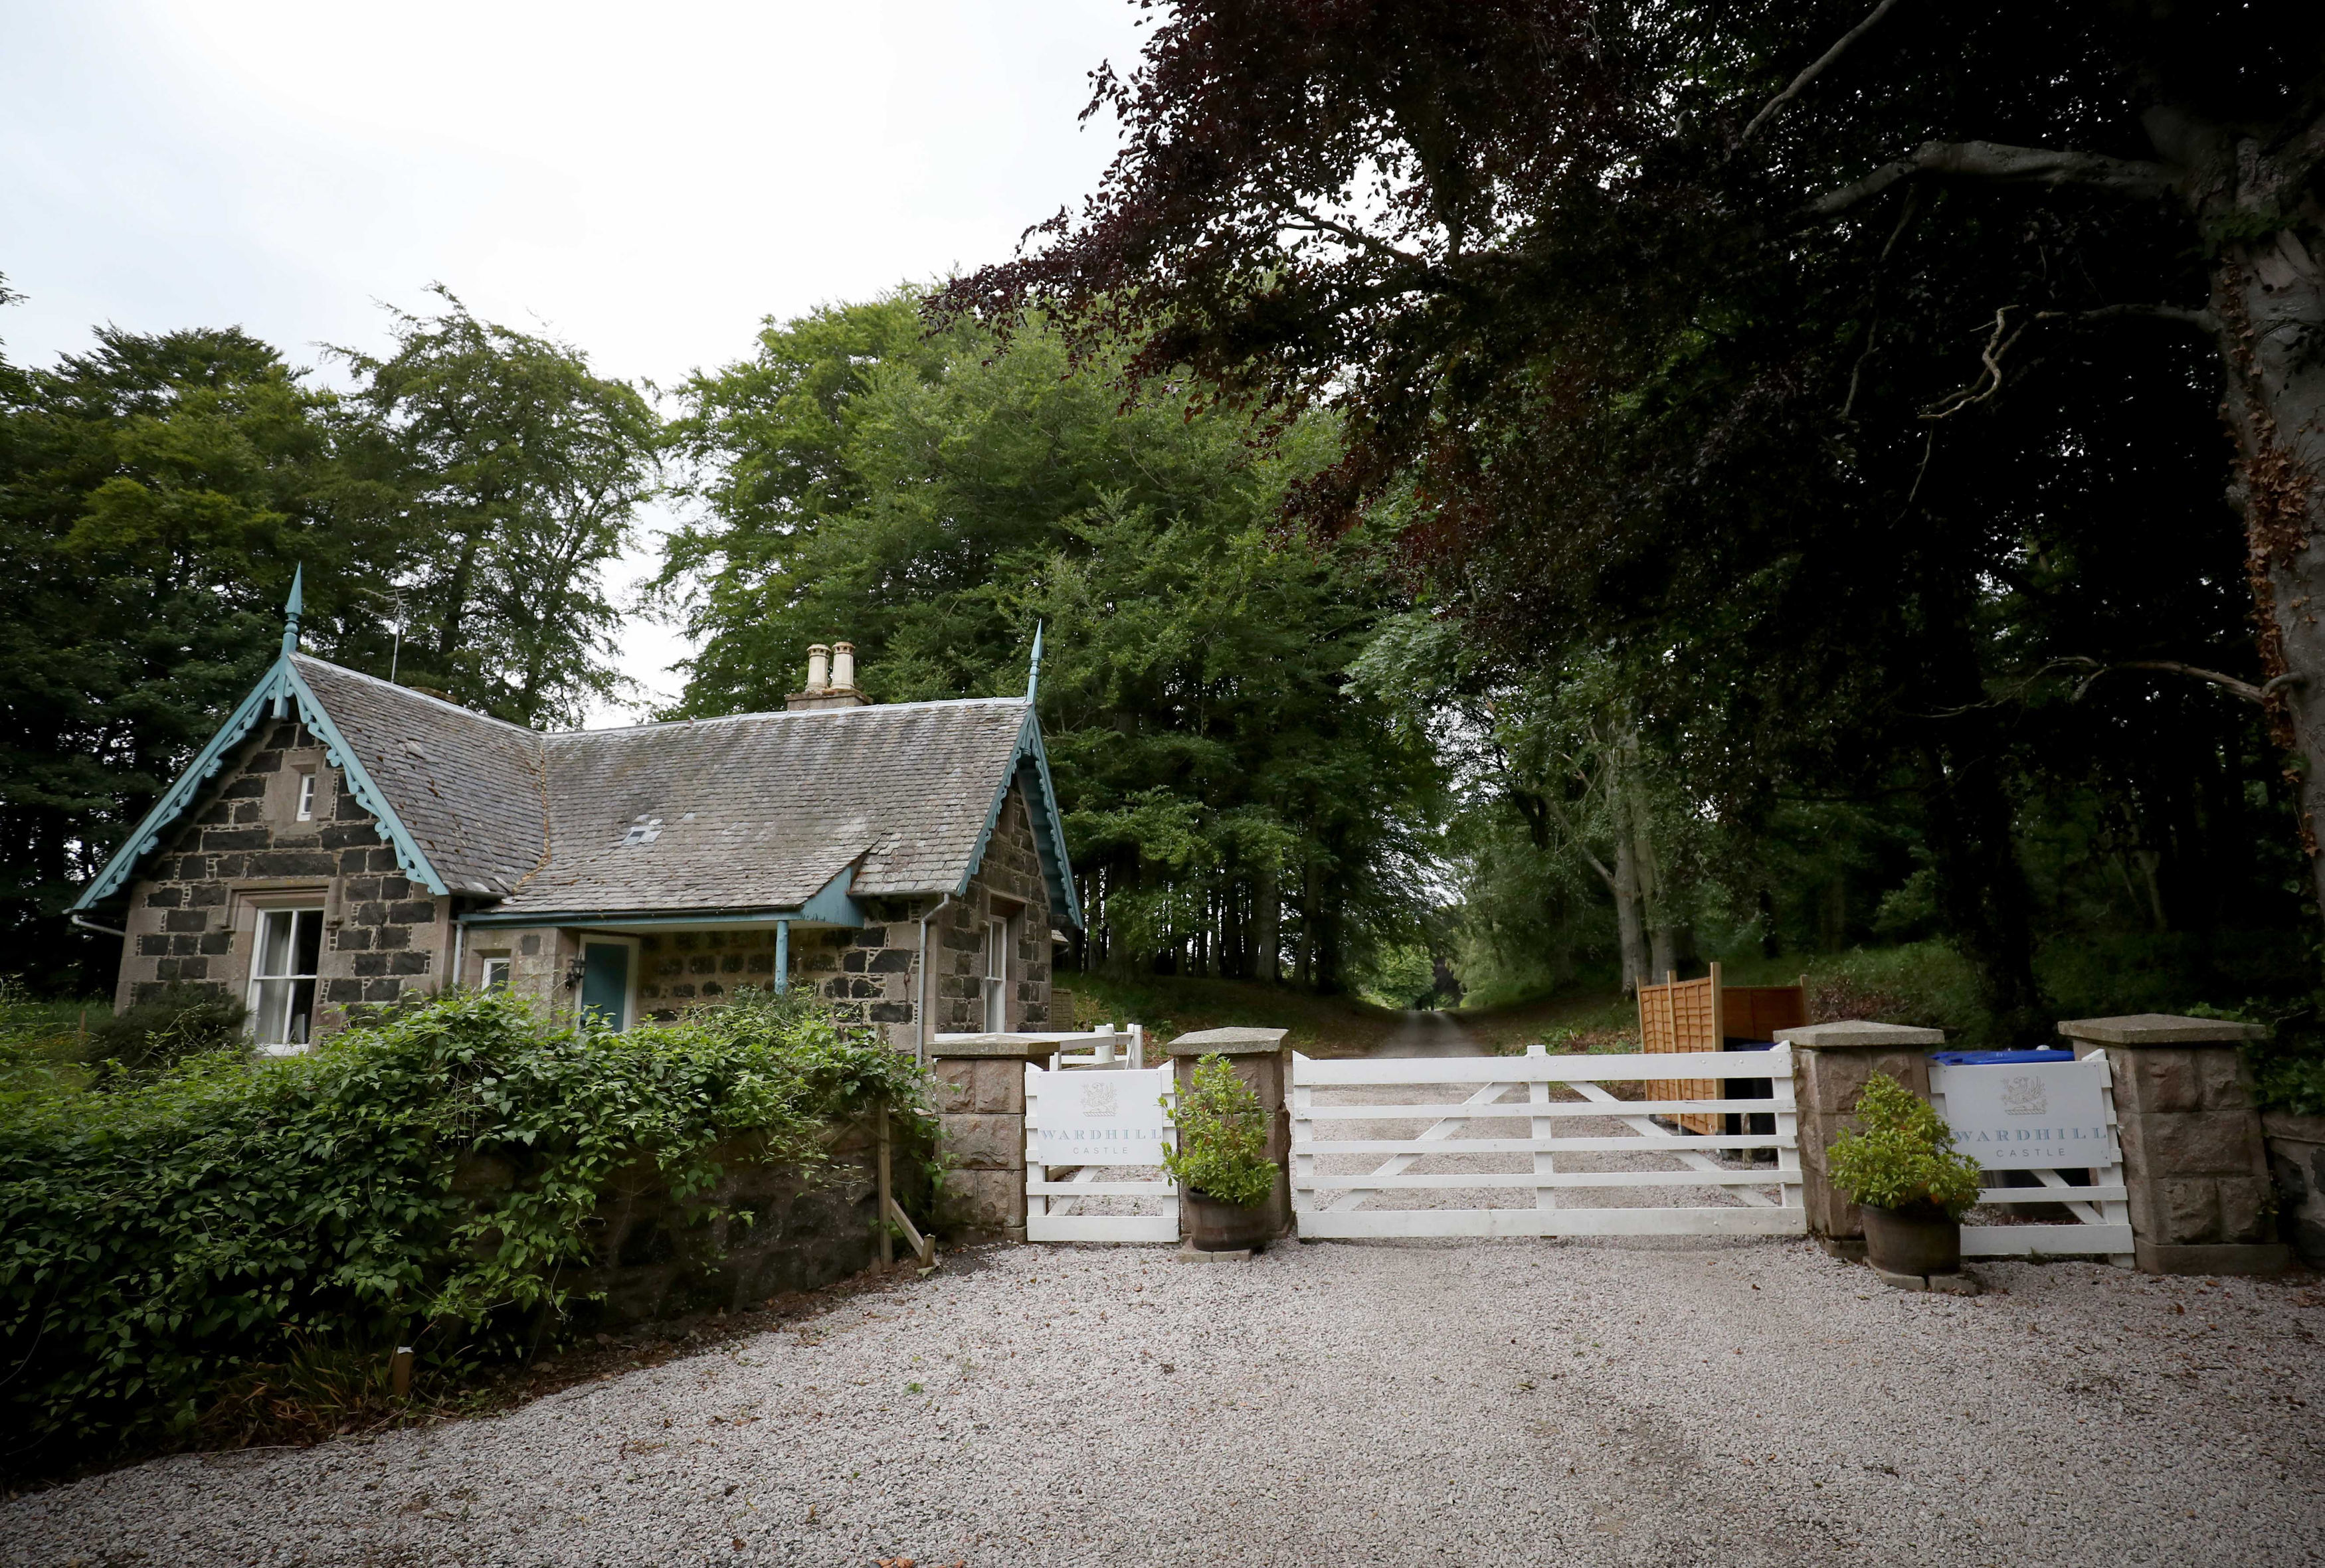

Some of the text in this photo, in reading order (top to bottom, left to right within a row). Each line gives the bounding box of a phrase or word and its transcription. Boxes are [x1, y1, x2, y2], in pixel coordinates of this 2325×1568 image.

[1040, 1129, 1162, 1140] WARDHILL
[1952, 1128, 2106, 1142] WARDHILL
[1996, 1148, 2065, 1158] CASTLE
